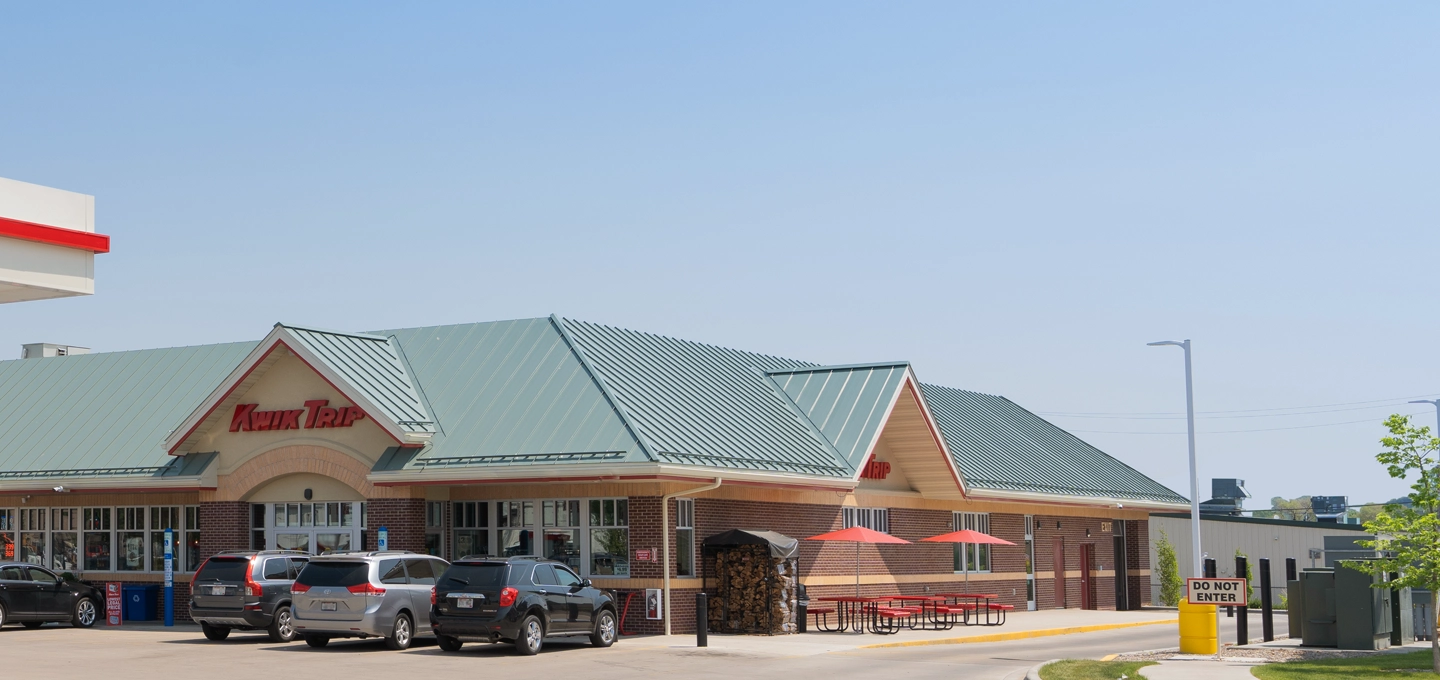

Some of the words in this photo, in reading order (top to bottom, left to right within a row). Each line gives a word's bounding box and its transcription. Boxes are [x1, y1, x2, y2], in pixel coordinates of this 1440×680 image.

[229, 403, 305, 432] KWIK
[304, 399, 366, 429] TRIP
[868, 454, 891, 479] TRIP
[1193, 582, 1210, 590] DO
[1214, 582, 1239, 590] NOT
[1197, 593, 1236, 602] ENTER
